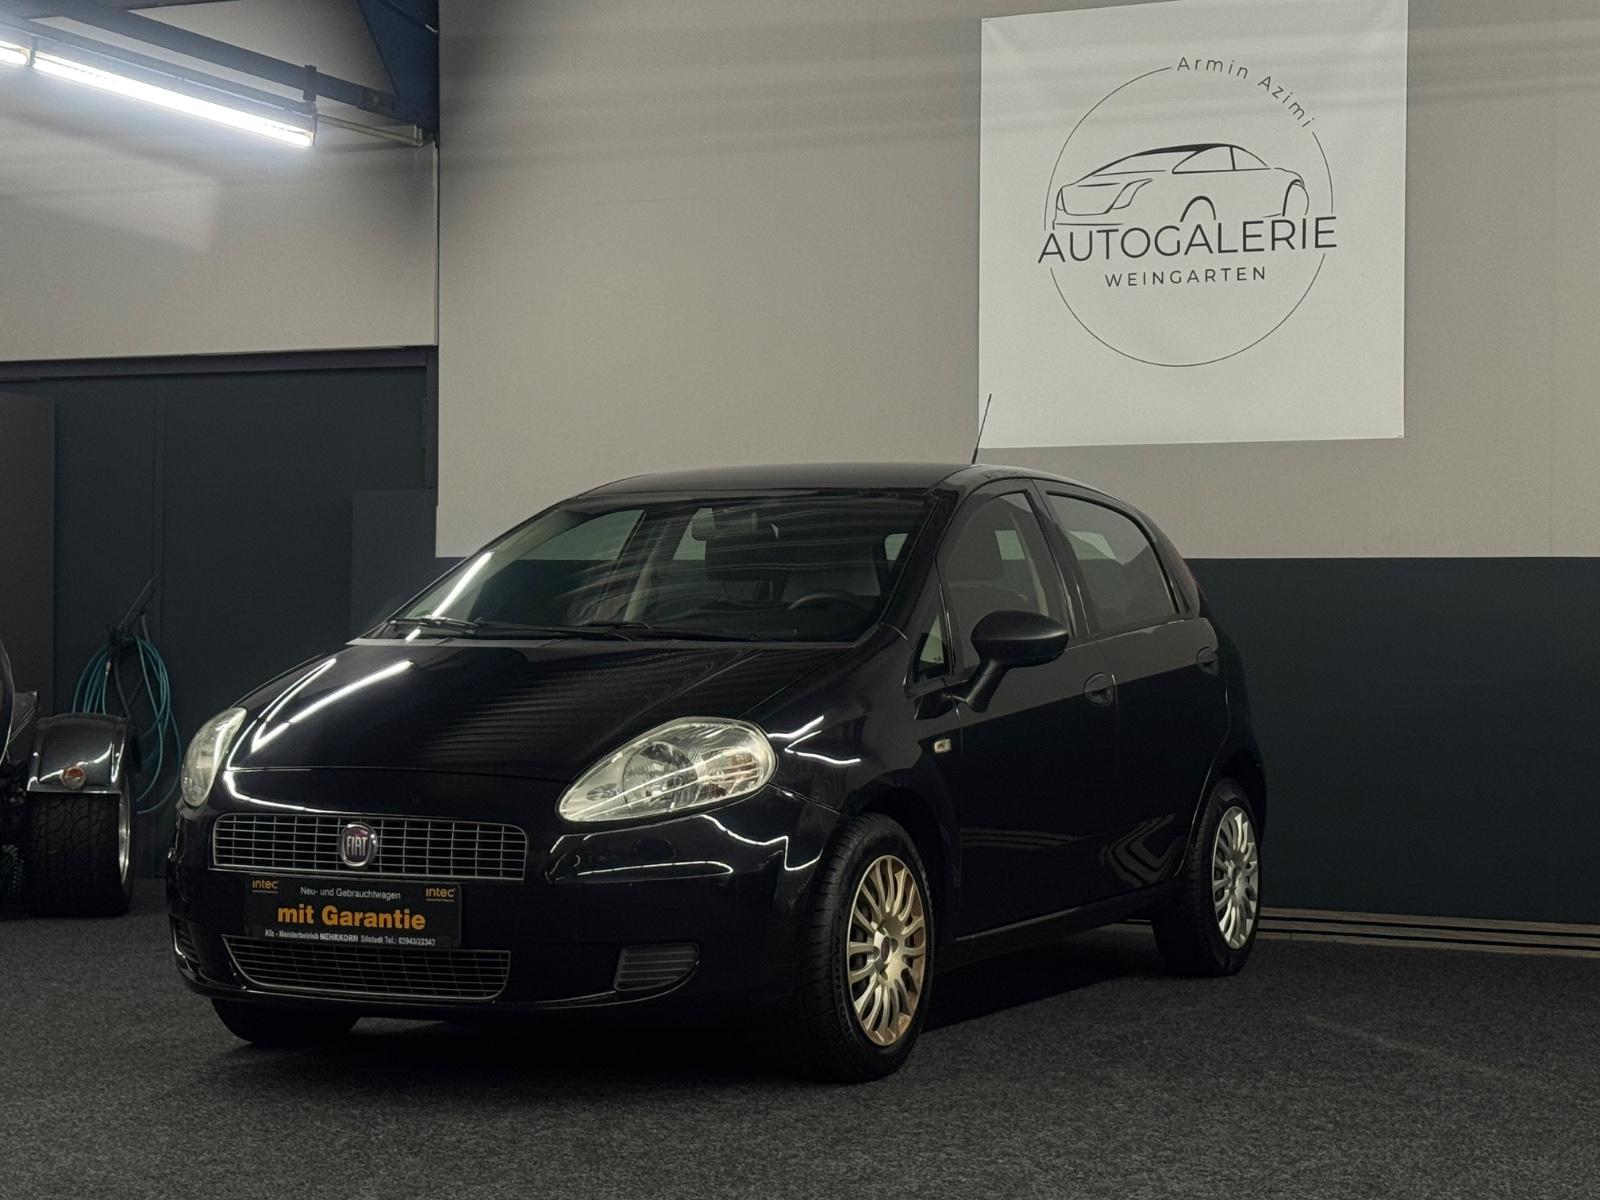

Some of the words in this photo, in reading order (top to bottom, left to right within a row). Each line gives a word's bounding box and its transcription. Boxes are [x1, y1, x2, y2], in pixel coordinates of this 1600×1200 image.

[1177, 56, 1248, 79] Armin
[1257, 75, 1315, 128] Azimi
[1037, 216, 1338, 264] AUTOGALERIE
[1104, 266, 1266, 288] WEINGARTEN
[347, 835, 367, 857] FIAT
[252, 879, 278, 889] intec
[300, 886, 318, 897] Neu-
[320, 887, 335, 897] und
[336, 888, 401, 901] Gebrauchtwagen
[425, 887, 454, 898] intec
[277, 903, 314, 925] mit
[321, 904, 427, 931] Garantie
[320, 933, 359, 942] NEHRKORN
